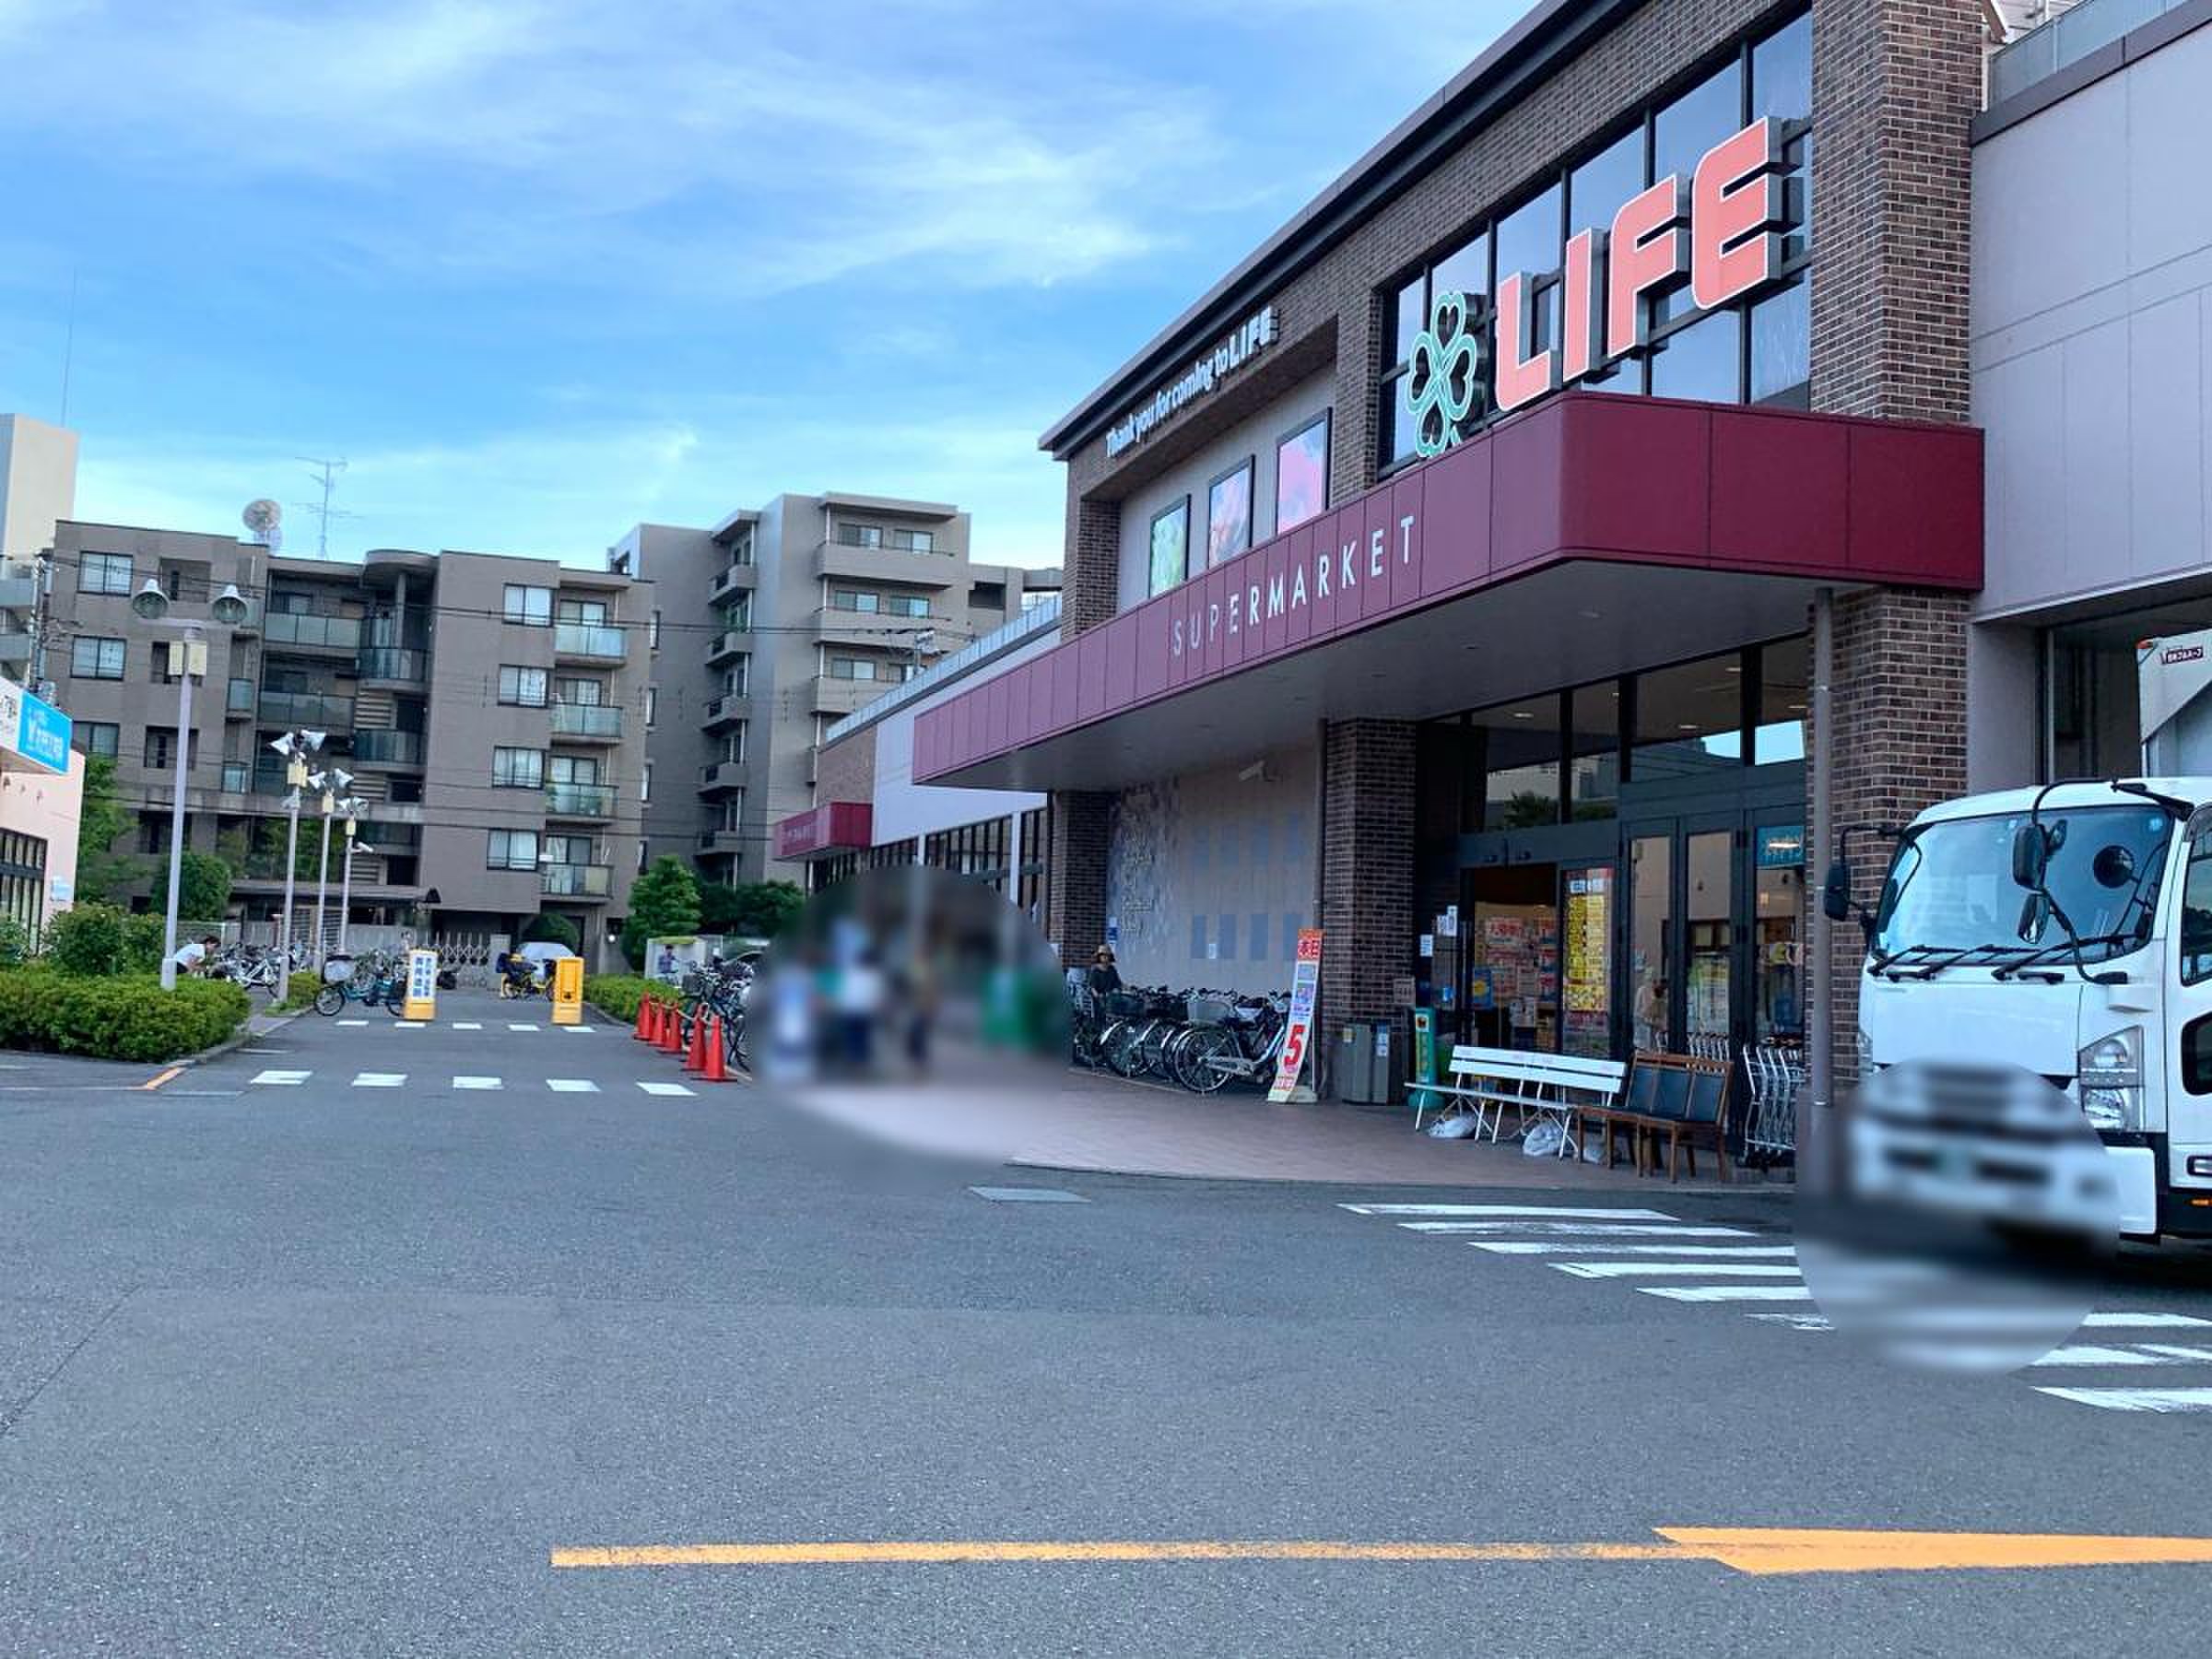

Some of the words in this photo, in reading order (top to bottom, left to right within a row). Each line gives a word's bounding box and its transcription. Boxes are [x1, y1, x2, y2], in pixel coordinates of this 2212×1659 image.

[1494, 116, 1771, 412] LIFE
[1106, 414, 1135, 458] Thank
[1135, 405, 1155, 443] you
[1155, 389, 1171, 423] for
[1171, 359, 1214, 408] coming
[1215, 348, 1228, 378] to
[1229, 305, 1272, 370] LIFE
[1171, 514, 1415, 657] SUPERMARKET
[1284, 1024, 1305, 1066] 5
